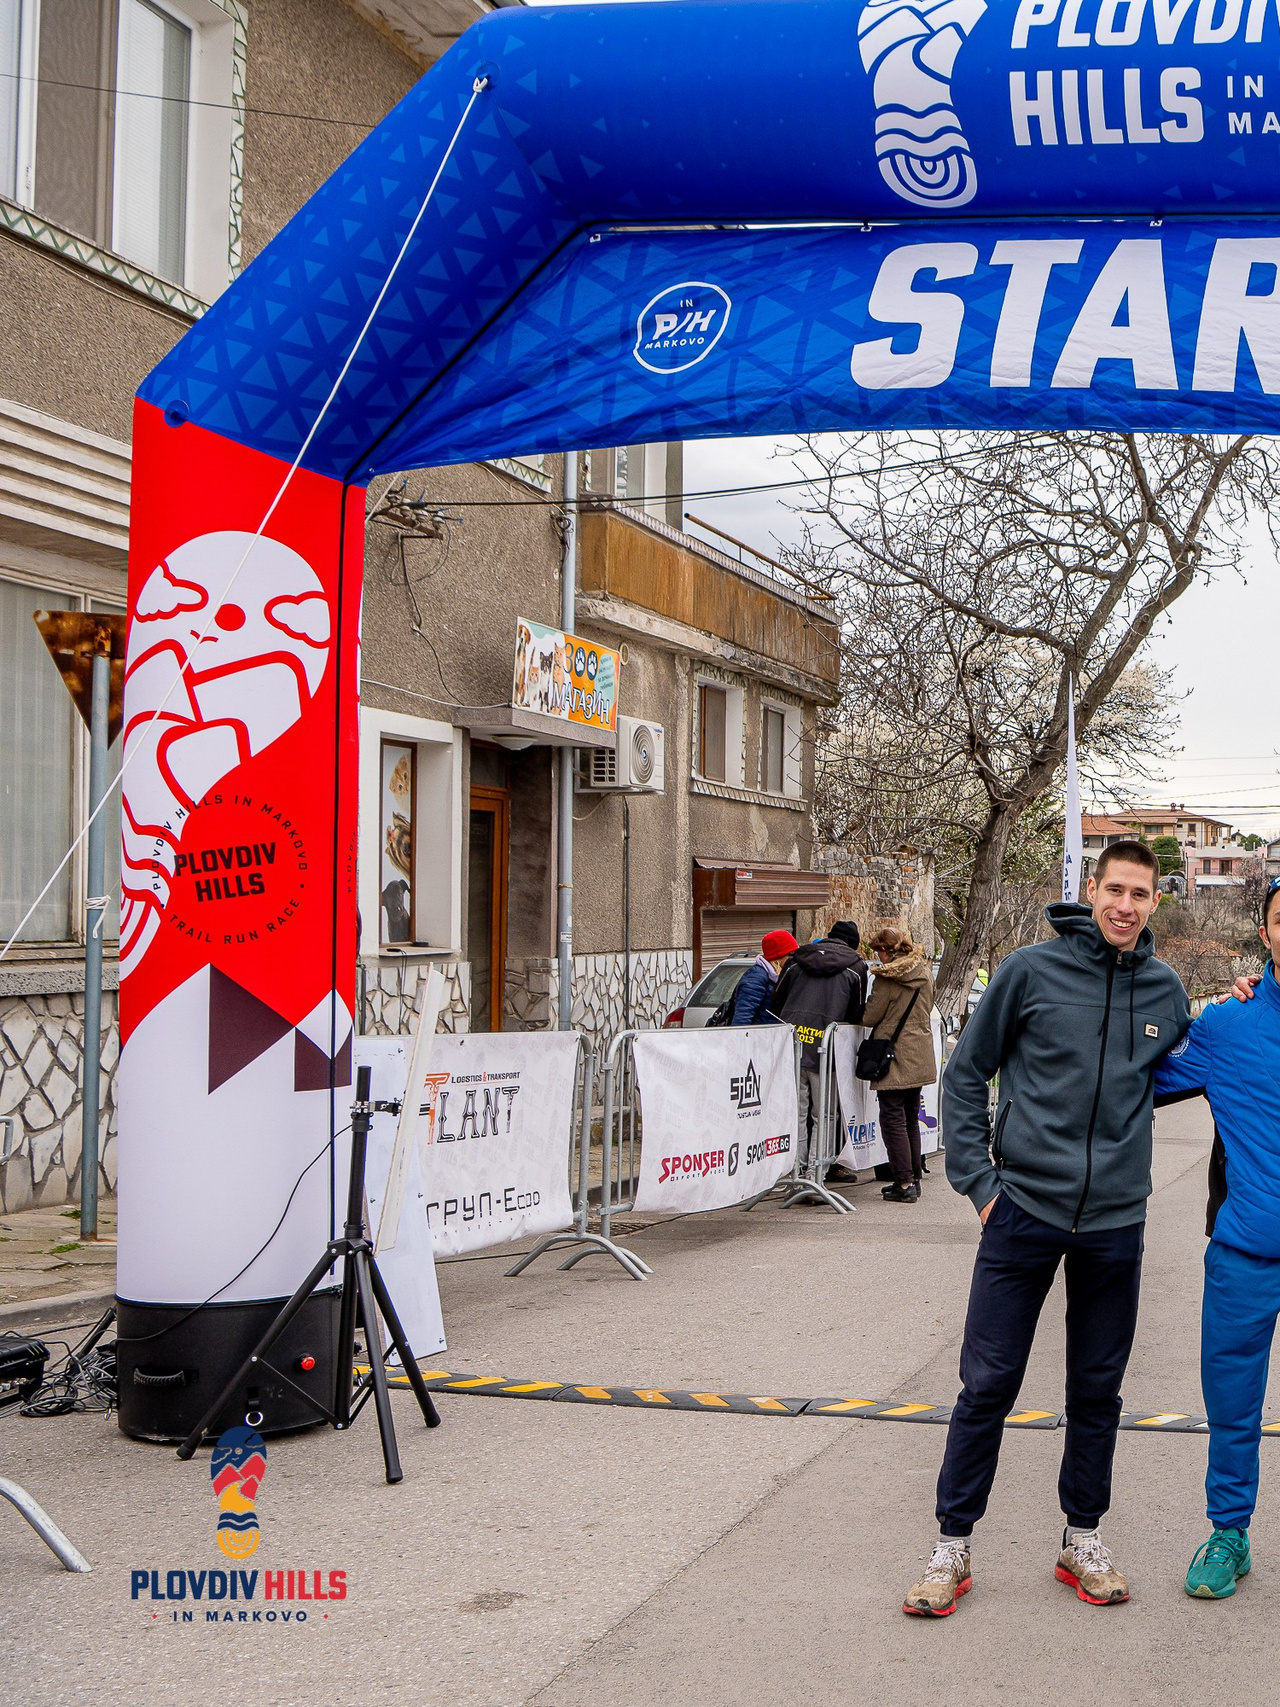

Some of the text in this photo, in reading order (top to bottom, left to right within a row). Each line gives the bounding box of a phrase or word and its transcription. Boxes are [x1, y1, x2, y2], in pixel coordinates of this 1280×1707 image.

[1226, 75, 1264, 98] IN
[1008, 67, 1204, 146] HILLS
[680, 299, 694, 308] IN
[652, 309, 717, 340] P/H
[644, 337, 705, 350] MARKOVO
[552, 681, 610, 724] МАГАЗИН
[234, 795, 252, 806] IN
[261, 803, 308, 871] MARKOVO
[174, 842, 277, 877] PLOVDIV
[195, 872, 265, 902] HILLS
[169, 898, 300, 945] TRAIL RUN RACE
[658, 1150, 725, 1184] SPONSER
